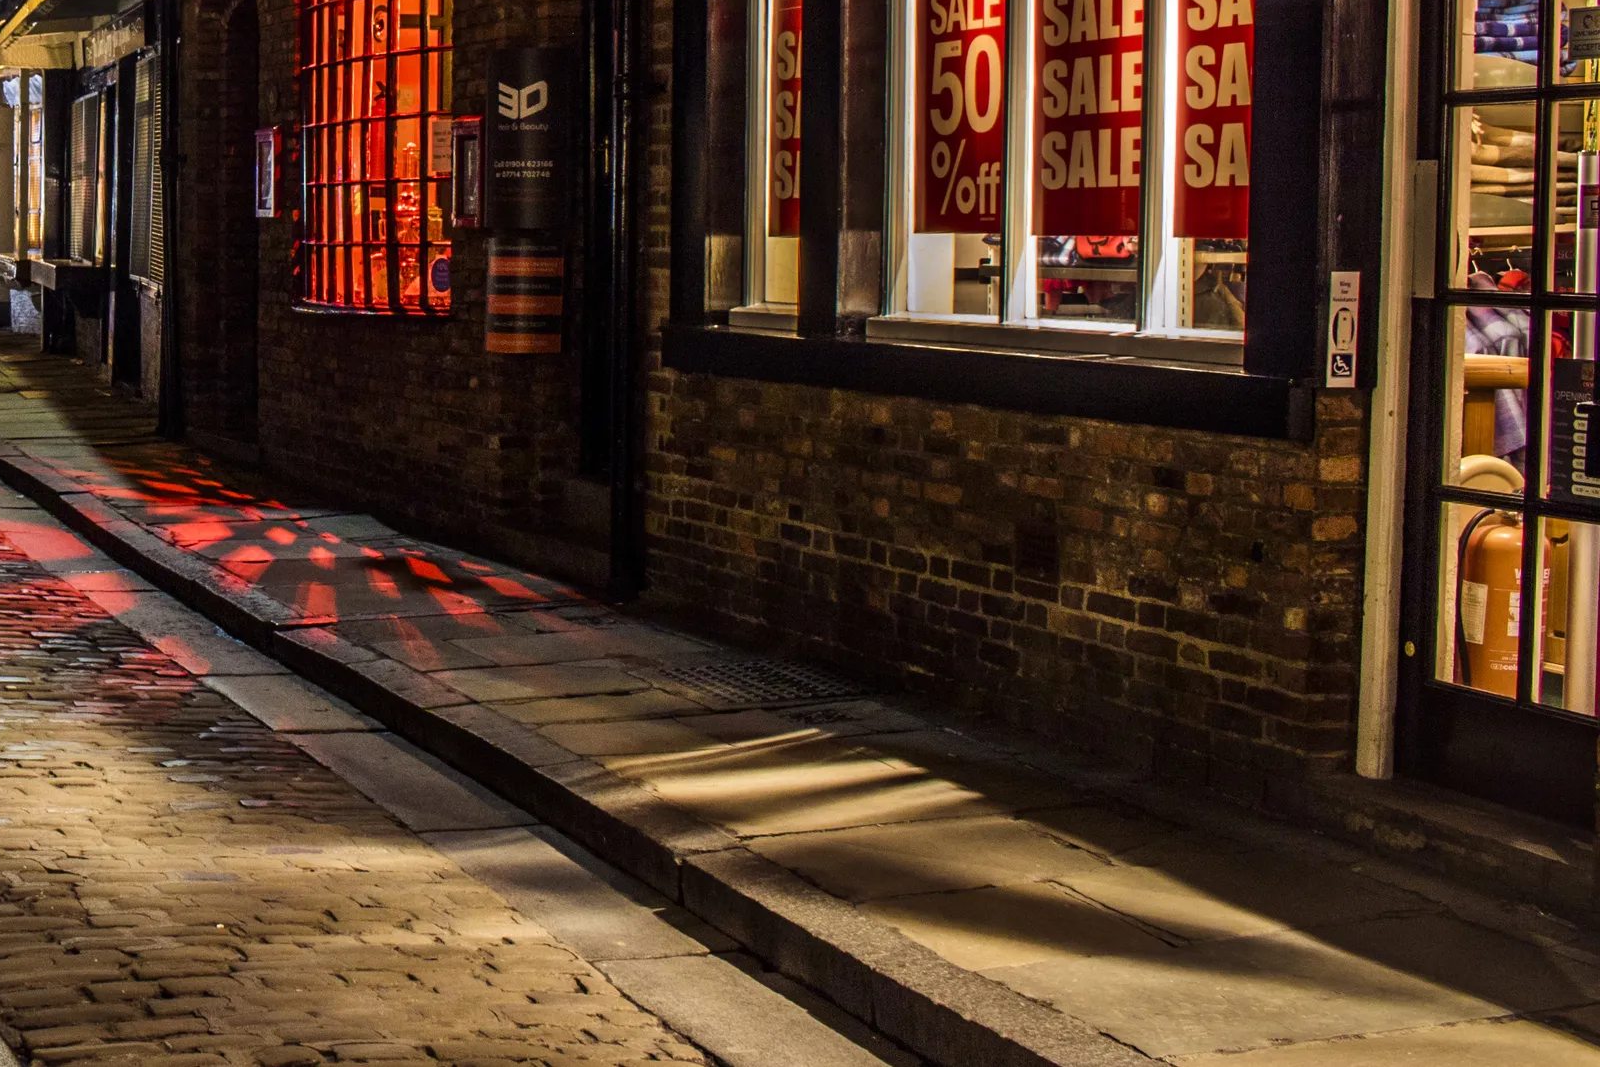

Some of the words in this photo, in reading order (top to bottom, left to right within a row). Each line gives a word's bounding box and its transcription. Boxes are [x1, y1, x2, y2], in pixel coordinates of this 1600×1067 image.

[930, 34, 1001, 136] 50
[1042, 50, 1142, 119] SALE
[520, 123, 548, 132] Beauty
[1041, 126, 1140, 190] SALE
[1339, 280, 1351, 288] Ring
